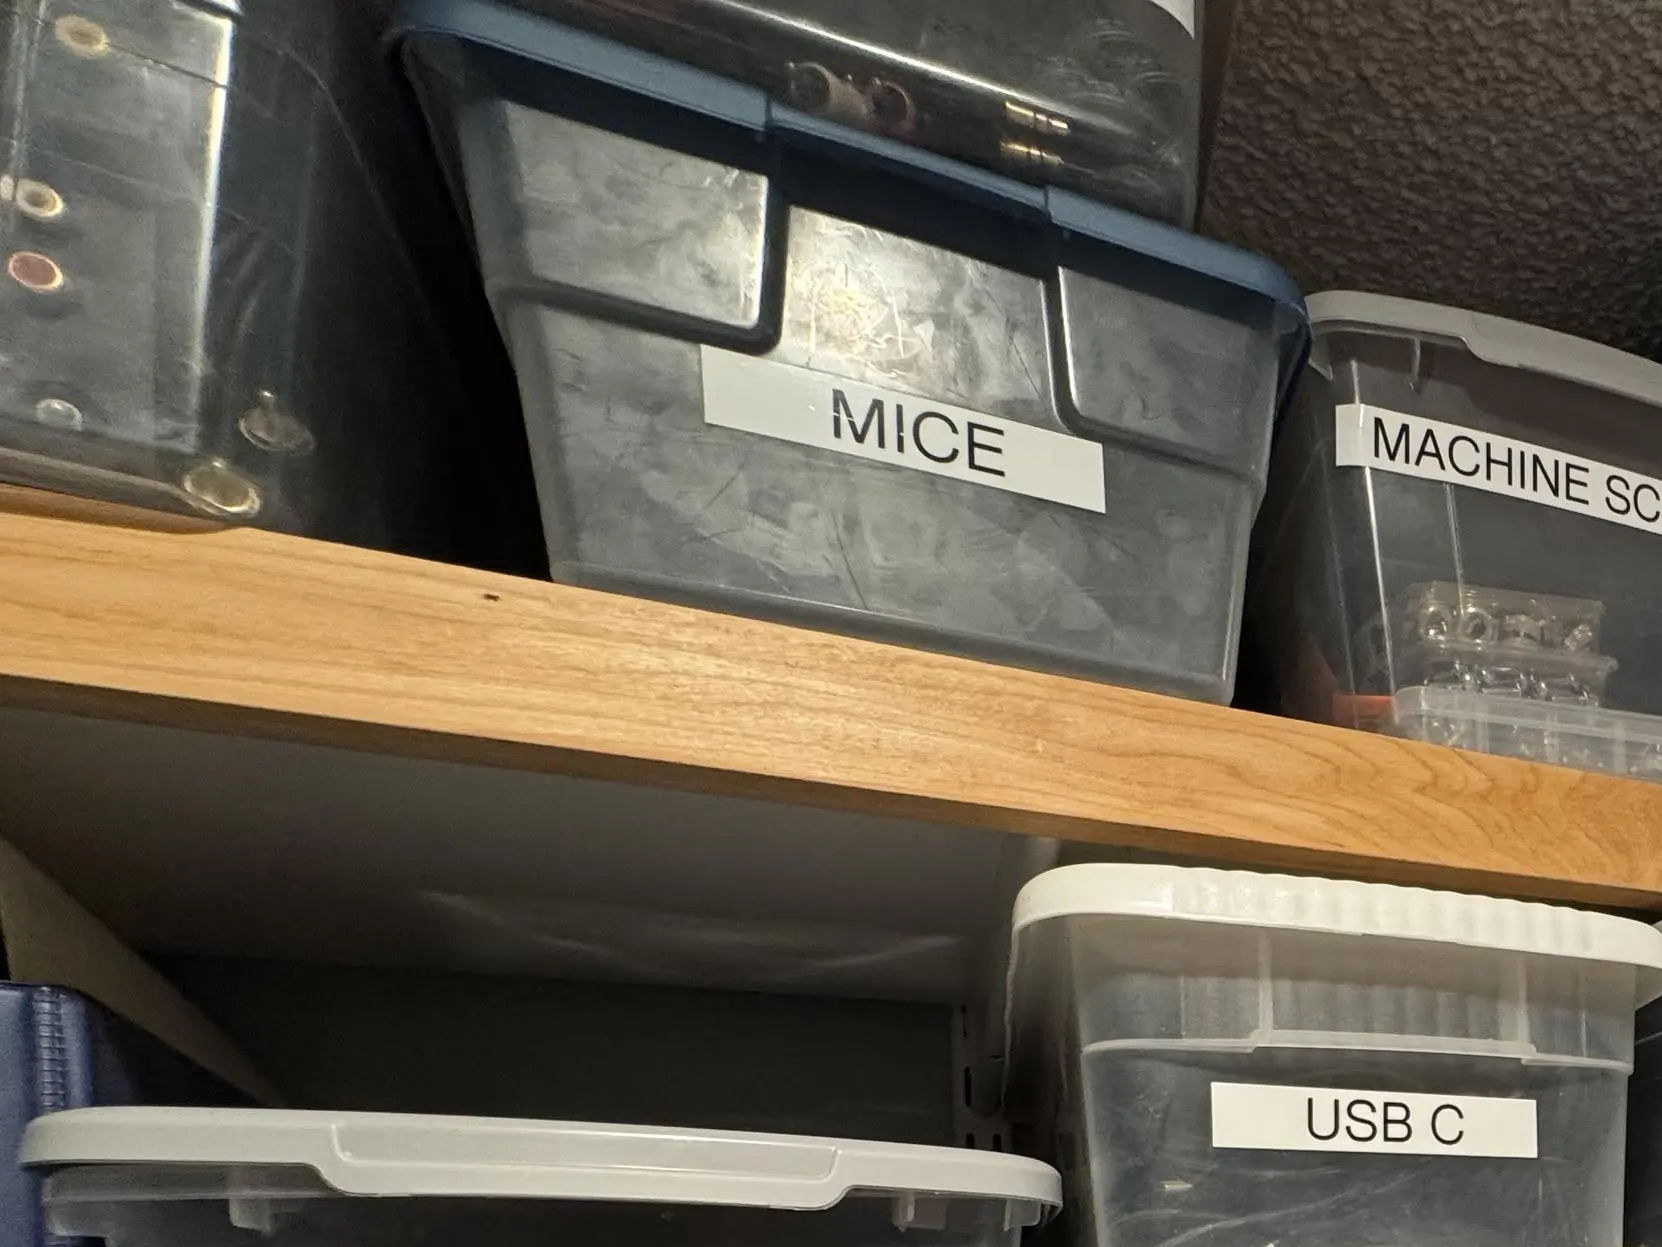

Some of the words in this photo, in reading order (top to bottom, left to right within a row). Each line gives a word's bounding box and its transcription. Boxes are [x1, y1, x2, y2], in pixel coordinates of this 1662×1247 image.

[833, 390, 1006, 477] MICE
[1374, 416, 1590, 505] MACHINE
[1307, 1098, 1413, 1143] USB
[1431, 1103, 1464, 1146] C
